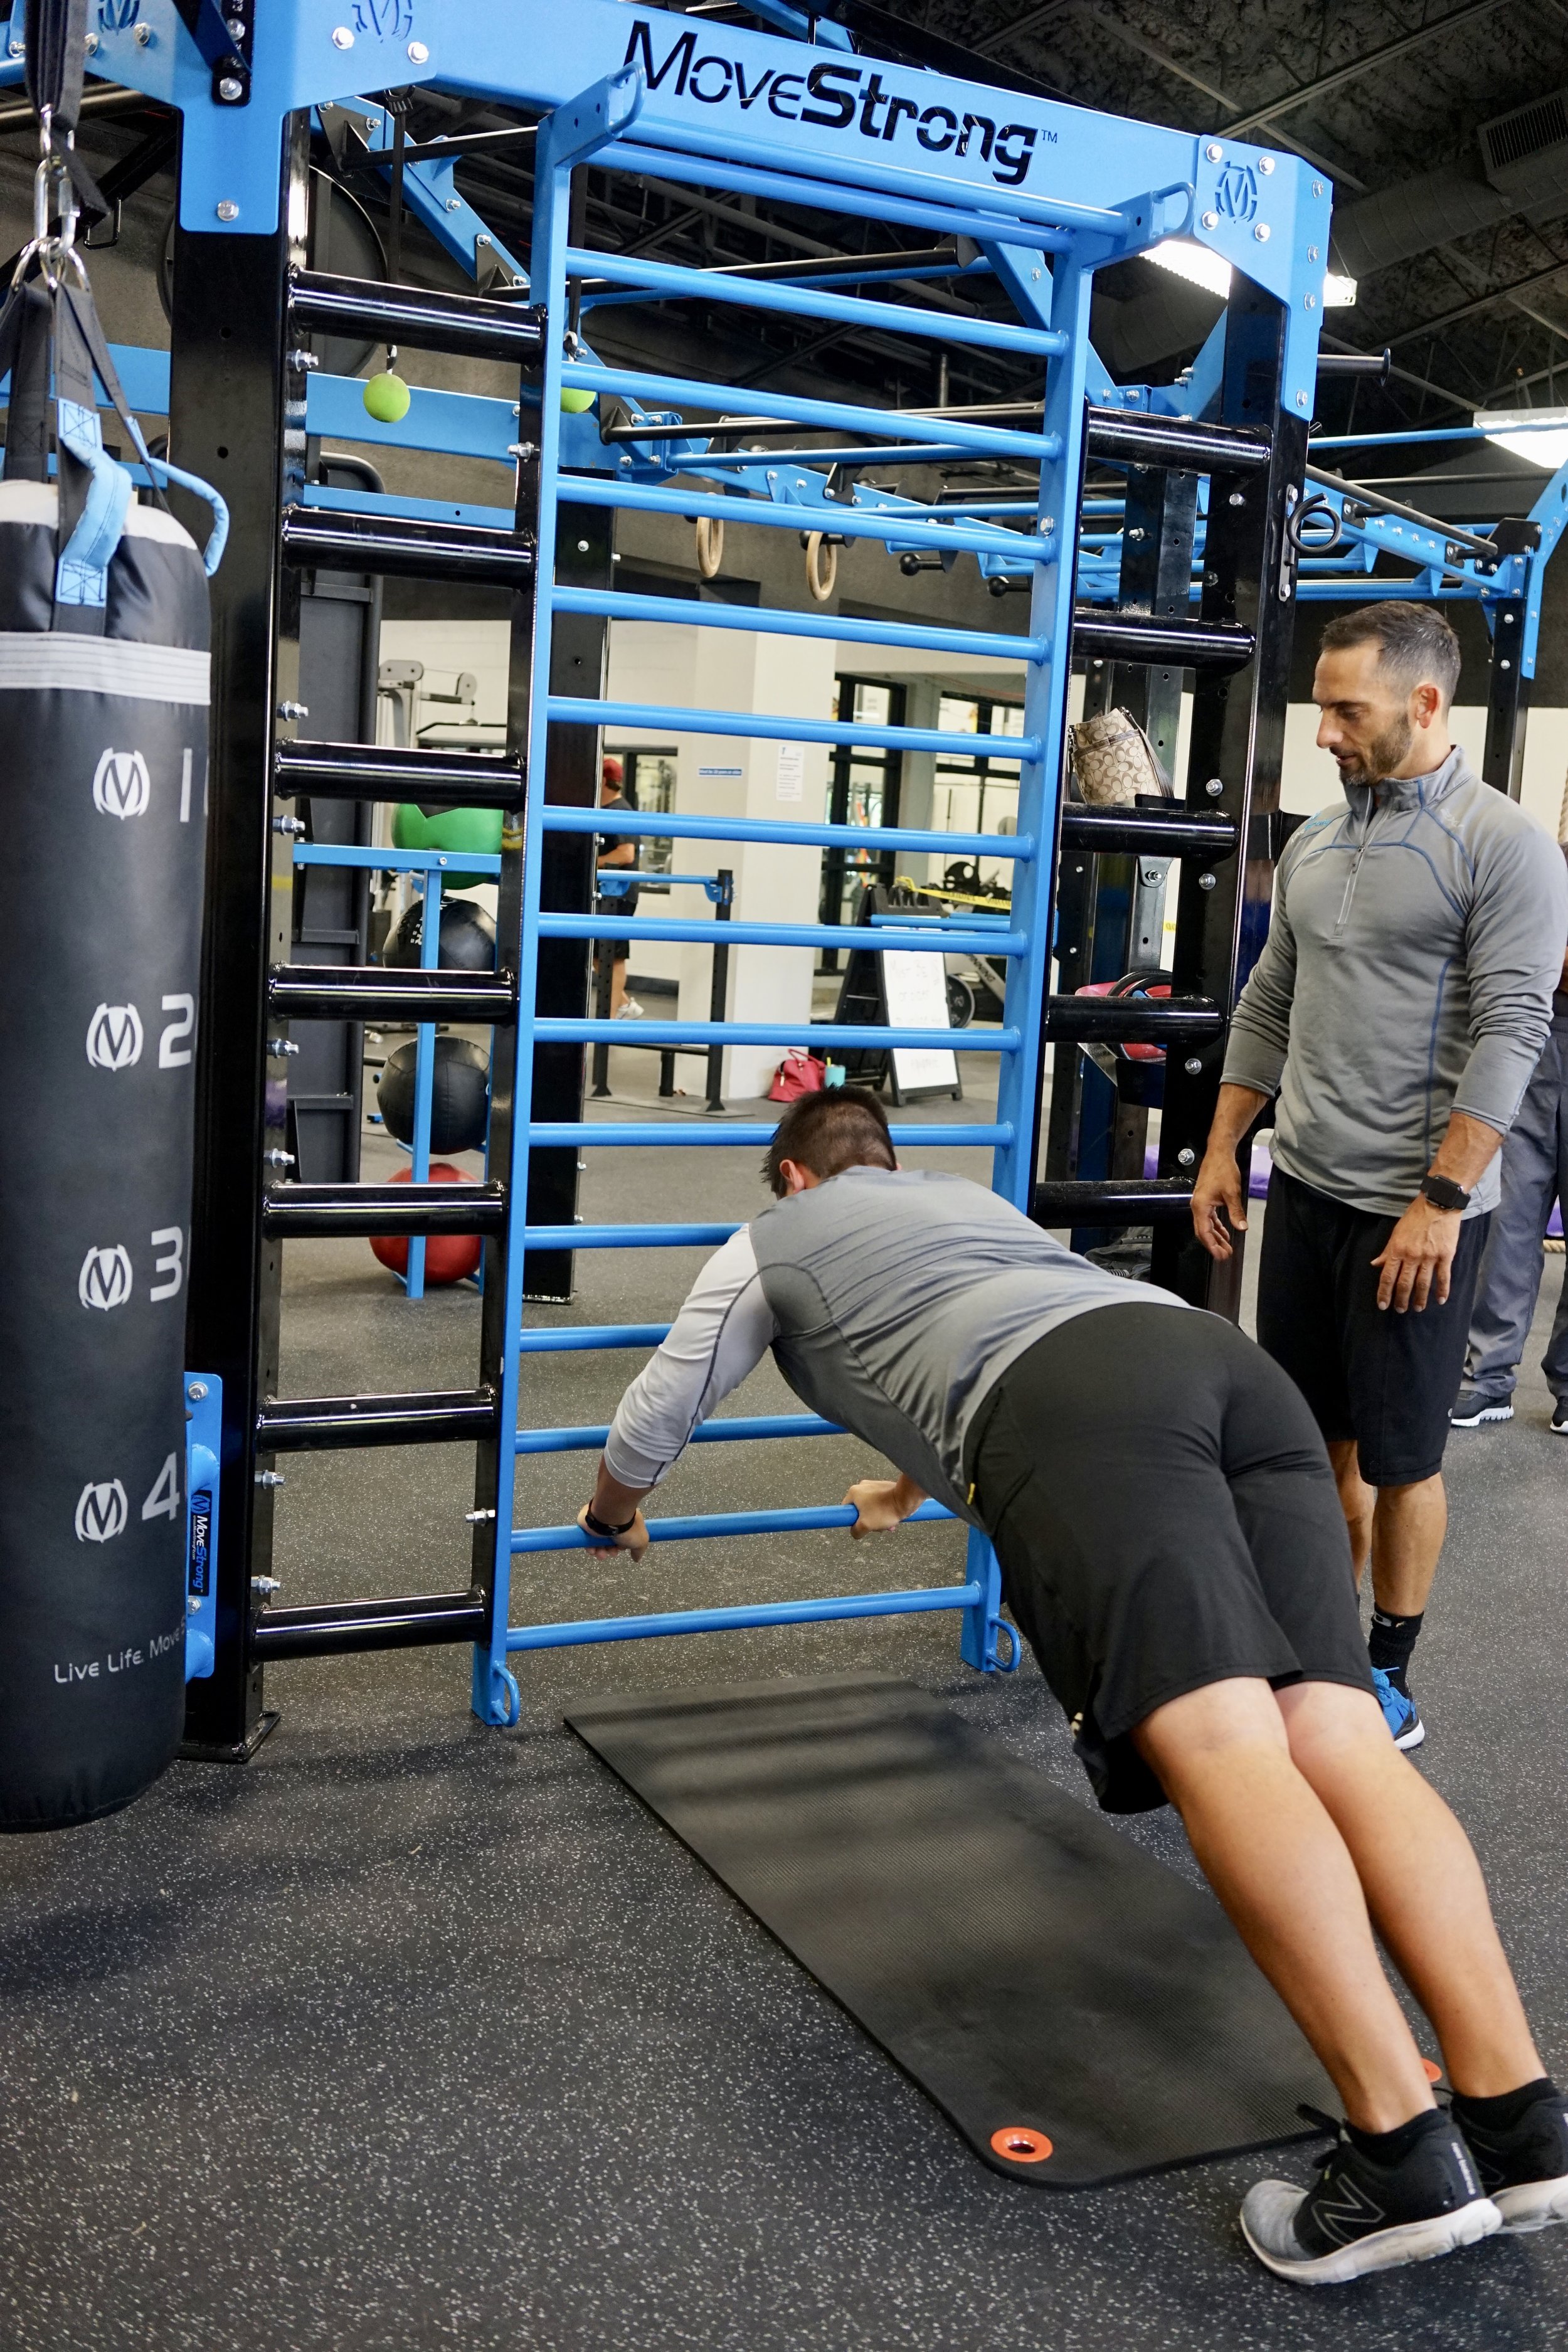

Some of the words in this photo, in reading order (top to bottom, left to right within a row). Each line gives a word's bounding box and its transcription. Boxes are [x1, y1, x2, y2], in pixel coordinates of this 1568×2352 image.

[623, 20, 1039, 186] MoveStrong
[180, 747, 193, 823] 1
[159, 992, 194, 1069] 2
[150, 1226, 184, 1303] 3
[141, 1451, 181, 1522] 4
[193, 1515, 208, 1590] MoveStrong
[54, 1662, 100, 1683] Live
